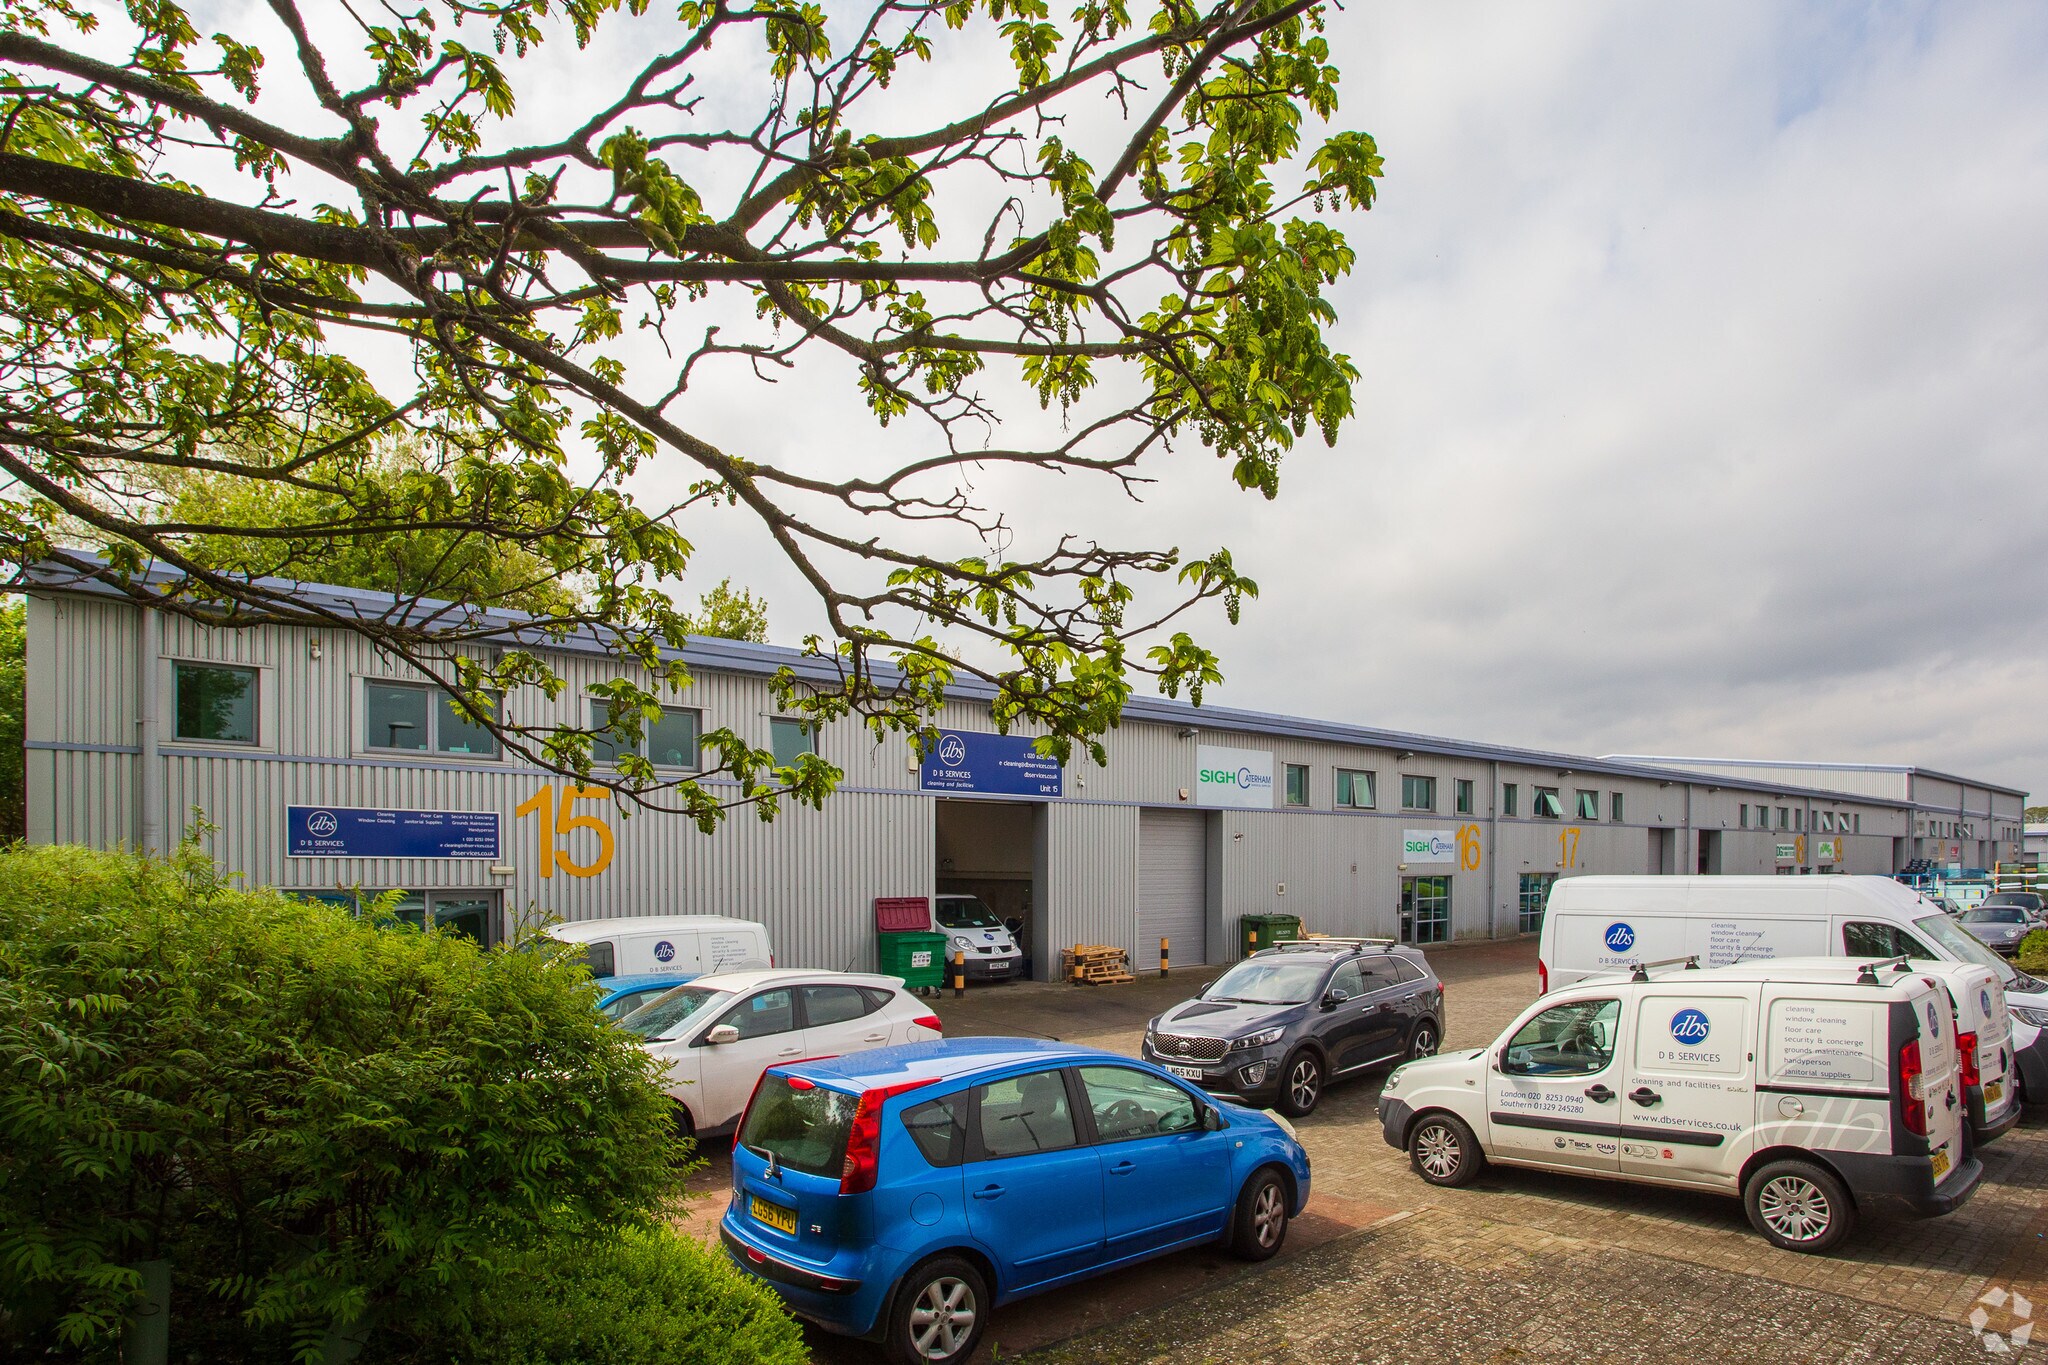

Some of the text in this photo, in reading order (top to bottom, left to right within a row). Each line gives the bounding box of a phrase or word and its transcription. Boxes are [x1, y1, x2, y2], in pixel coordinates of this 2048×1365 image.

[941, 741, 964, 758] dbs
[945, 770, 971, 779] SERVICES
[1199, 767, 1272, 789] SIGH CATERHAM
[1040, 785, 1058, 793] Unit 15
[310, 816, 336, 831] dbs
[516, 784, 615, 878] 15
[1405, 841, 1430, 852] SIGH
[1455, 824, 1481, 871] 16
[1559, 827, 1581, 869] 17
[1607, 928, 1634, 945] dbs
[655, 944, 674, 958] dbs
[1785, 1006, 1815, 1014] cleaning
[1672, 1015, 1709, 1037] dbs
[1816, 1017, 1847, 1025] cleaning
[1826, 1039, 1864, 1047] concierge
[1658, 1051, 1720, 1063] D B SERVICES
[1815, 1048, 1863, 1057] maintenance
[1784, 1057, 1831, 1066] handyperson
[1186, 1069, 1200, 1078] KXU
[1784, 1069, 1851, 1079] janitorial supplies
[1631, 1077, 1663, 1088] cleaning
[1667, 1079, 1681, 1087] and
[1685, 1081, 1721, 1090] facilities
[1500, 1090, 1584, 1104] London 020 8253 0940
[1500, 1099, 1584, 1114] Southern 01329 245280
[1633, 1114, 1742, 1132] www.dbservices.co.uk
[776, 1208, 794, 1229] YPU
